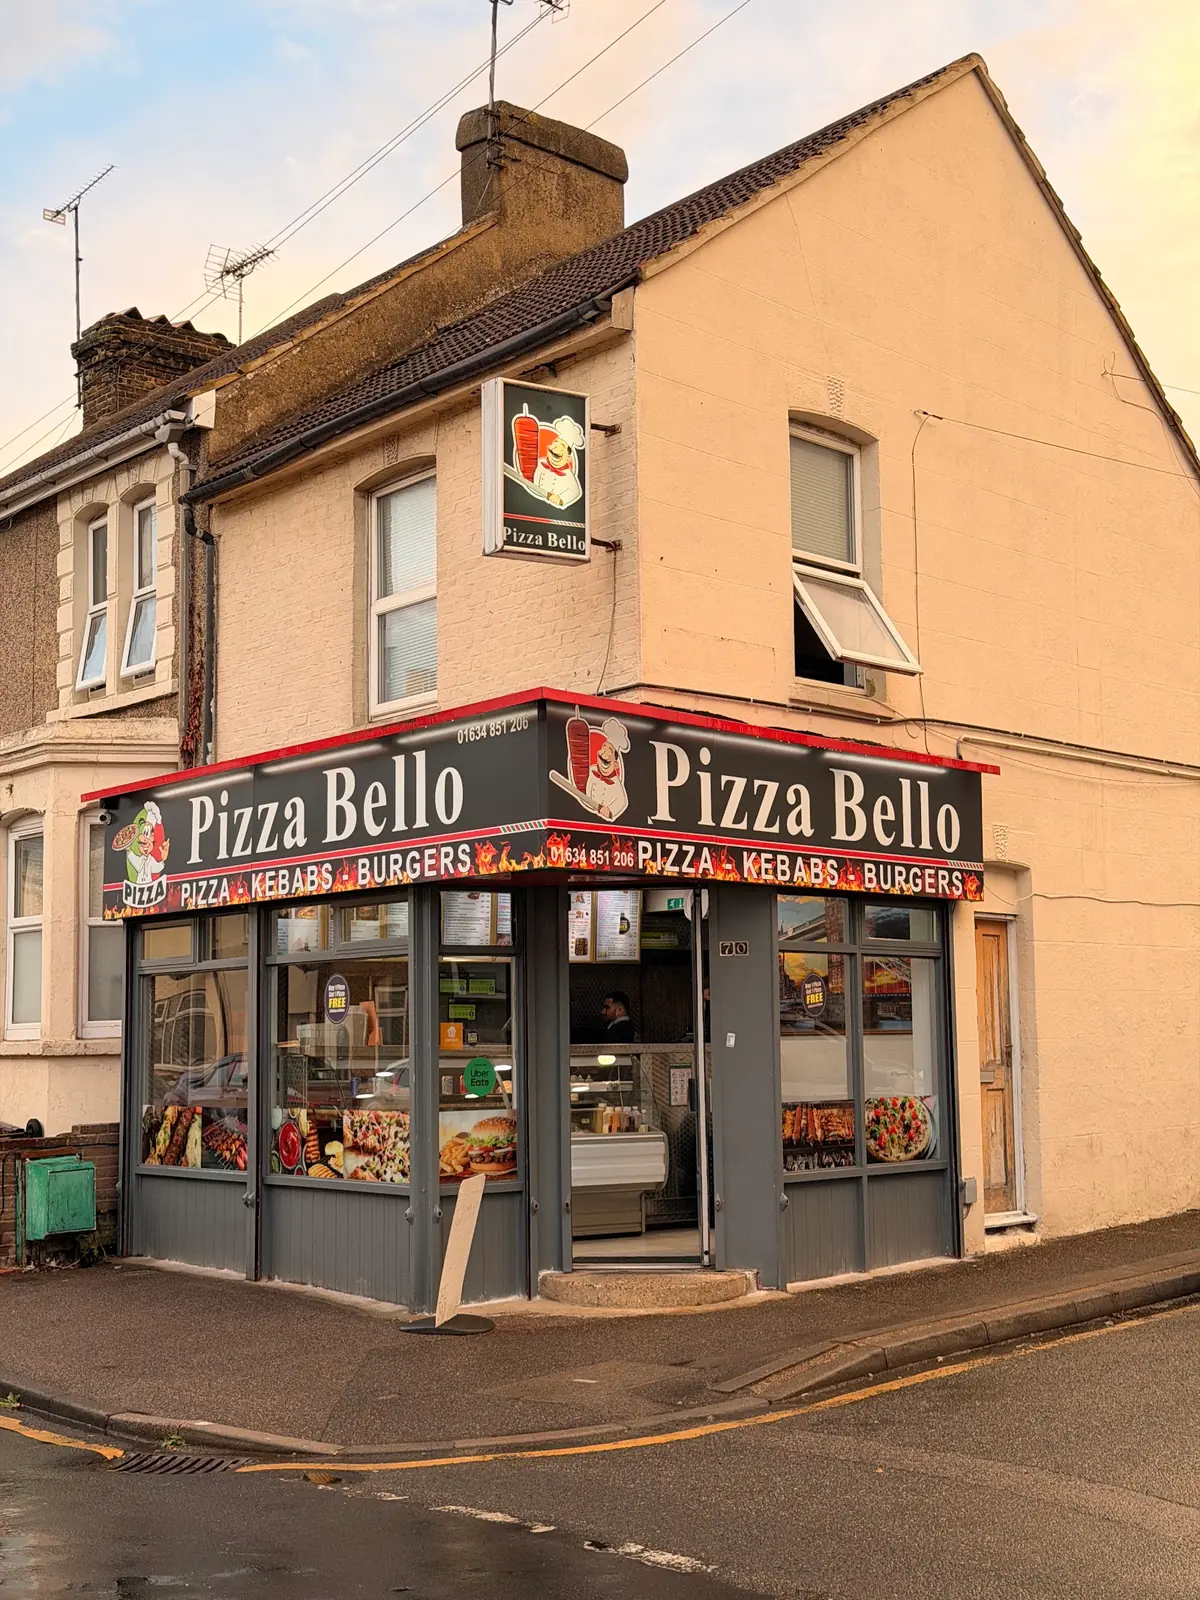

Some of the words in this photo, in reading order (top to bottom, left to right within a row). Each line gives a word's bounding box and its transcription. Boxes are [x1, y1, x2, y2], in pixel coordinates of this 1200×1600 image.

[547, 532, 586, 551] Bello
[457, 724, 487, 744] 01634
[490, 719, 507, 737] 851
[510, 715, 529, 733] 206
[186, 790, 307, 864] Pizza
[322, 750, 464, 844] Bello
[649, 740, 814, 837] Pizza
[830, 767, 960, 854] Bello
[550, 846, 587, 863] 01634
[589, 849, 610, 865] 851
[613, 851, 634, 867] 206
[180, 879, 229, 908] PIZZA
[251, 862, 333, 900] KEBABS
[358, 843, 472, 886] BURGERS
[638, 841, 715, 875] PIZZA
[743, 851, 840, 887] KEBABS
[864, 861, 963, 897] BURGERS
[124, 877, 166, 907] PIZZA
[721, 942, 747, 955] 70
[328, 998, 346, 1008] FREE
[806, 992, 823, 1004] FREE
[470, 1069, 490, 1078] Uber
[470, 1079, 490, 1087] Eats
